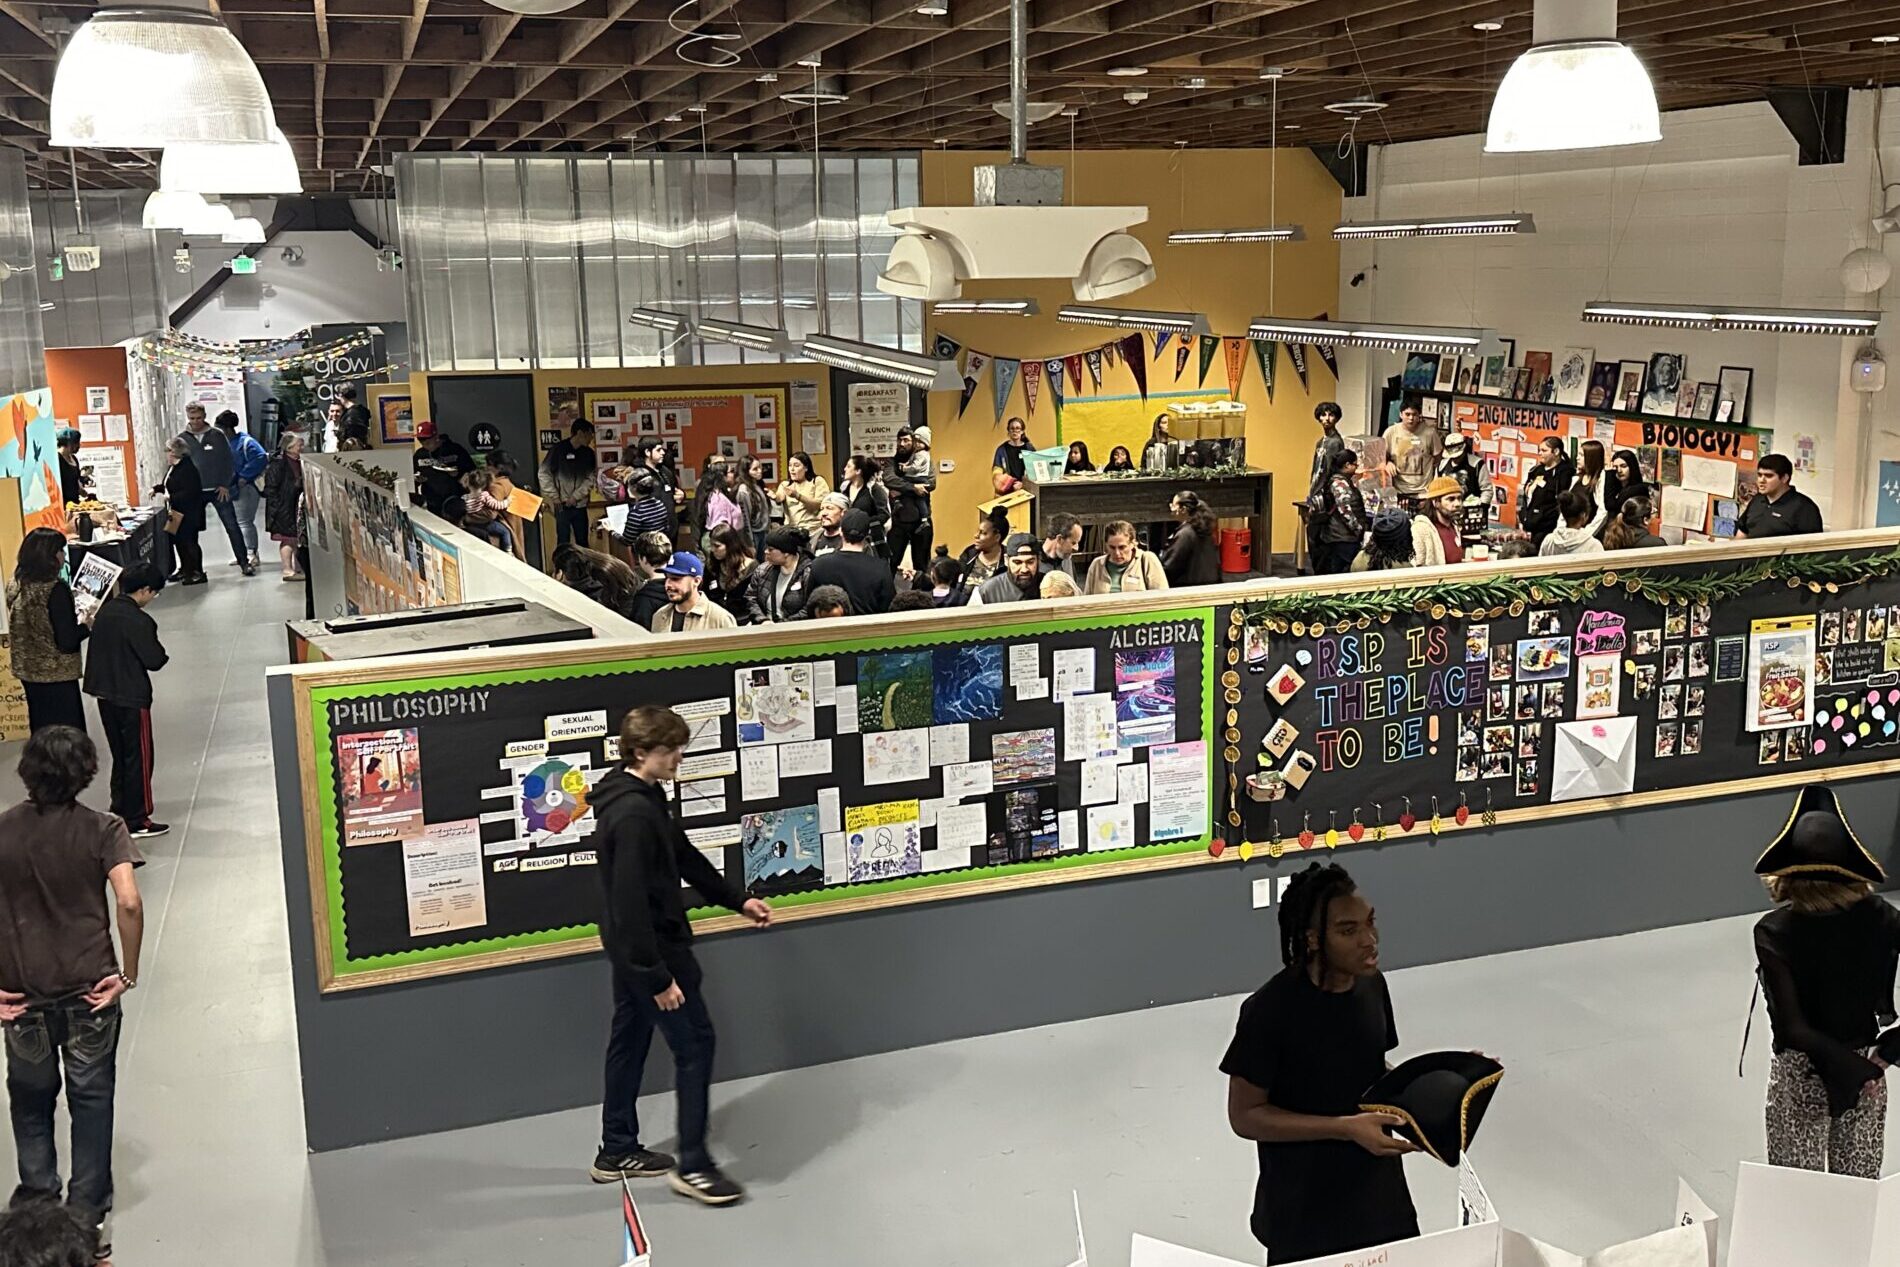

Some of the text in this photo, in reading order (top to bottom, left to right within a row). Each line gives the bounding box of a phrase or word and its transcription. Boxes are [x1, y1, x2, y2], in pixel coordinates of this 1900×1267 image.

[315, 357, 369, 378] grow
[1477, 404, 1559, 431] ENGINEERING
[1109, 623, 1199, 649] ALGEBRA
[1406, 625, 1448, 668] IS
[1764, 641, 1780, 651] RSP
[334, 691, 489, 726] PHILOSOPHY
[562, 714, 594, 725] SEXUAL
[551, 724, 606, 737] ORIENTATION
[510, 742, 545, 753] GENDER
[1315, 728, 1363, 772] TO
[349, 826, 399, 839] Philosophy
[498, 859, 517, 868] AGE
[526, 857, 565, 868] RELIGION
